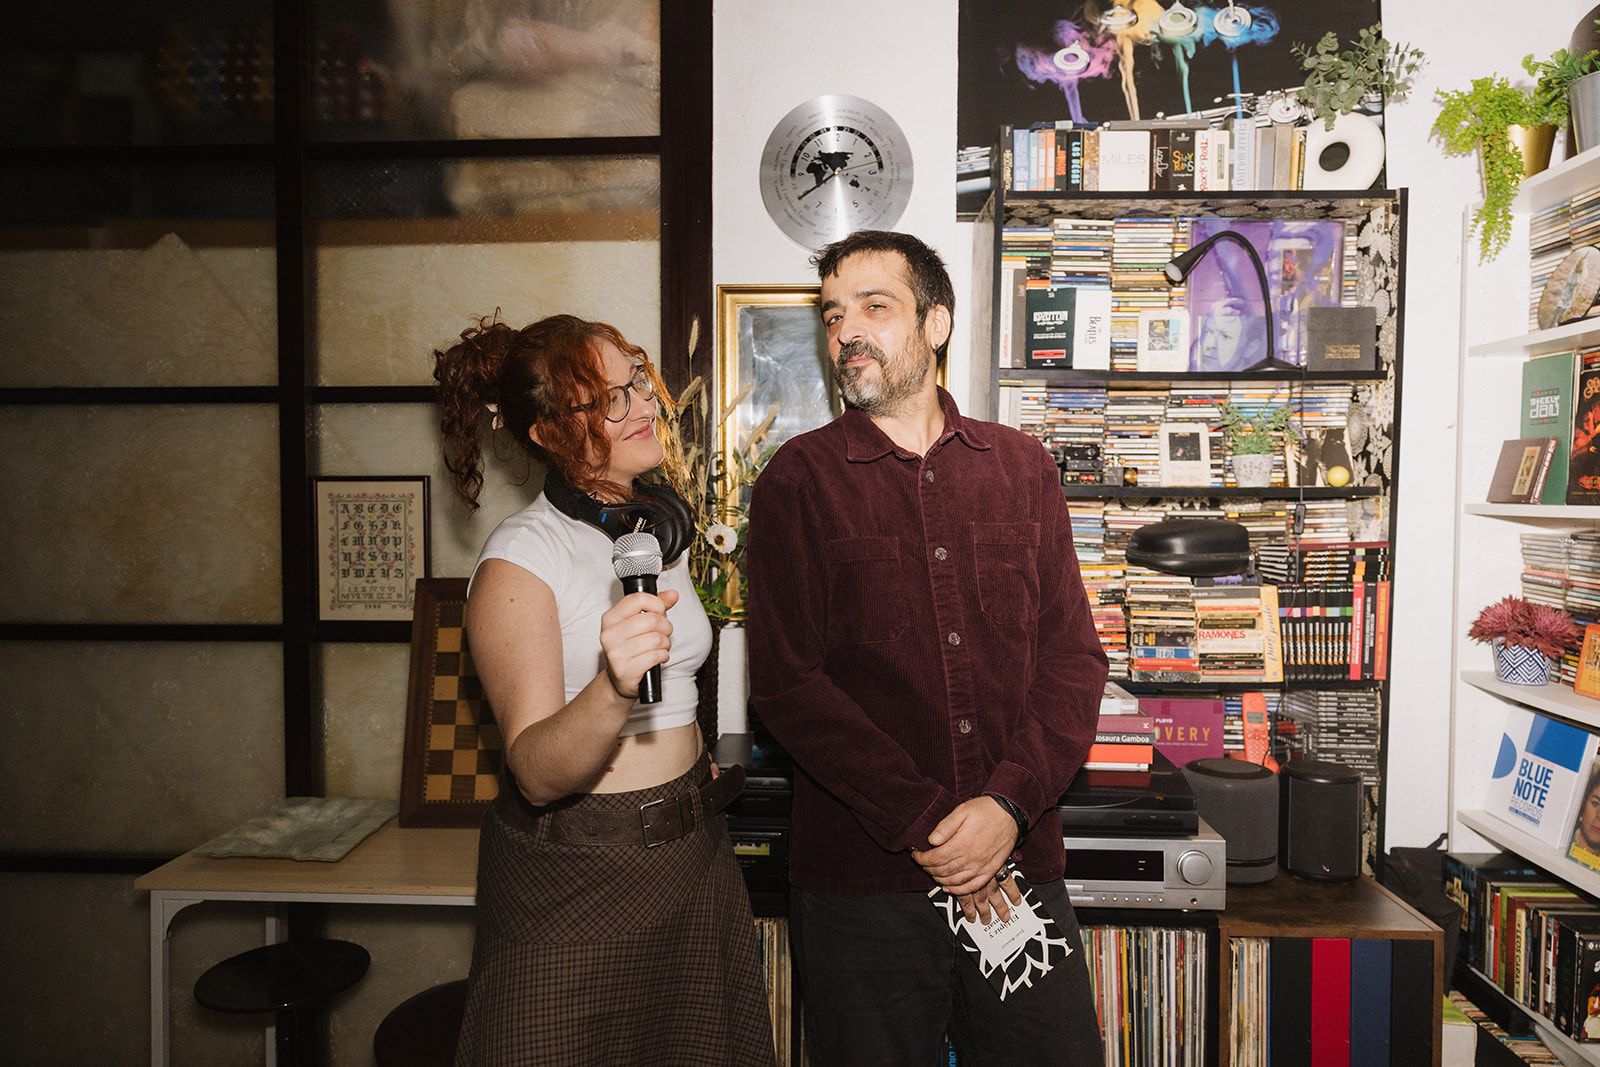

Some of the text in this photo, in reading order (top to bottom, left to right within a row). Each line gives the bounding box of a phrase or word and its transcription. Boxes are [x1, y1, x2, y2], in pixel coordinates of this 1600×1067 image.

[1102, 153, 1147, 166] MILES
[1198, 630, 1246, 640] RAMONES
[1518, 758, 1554, 788] BLUE
[1513, 778, 1549, 808] NOTE
